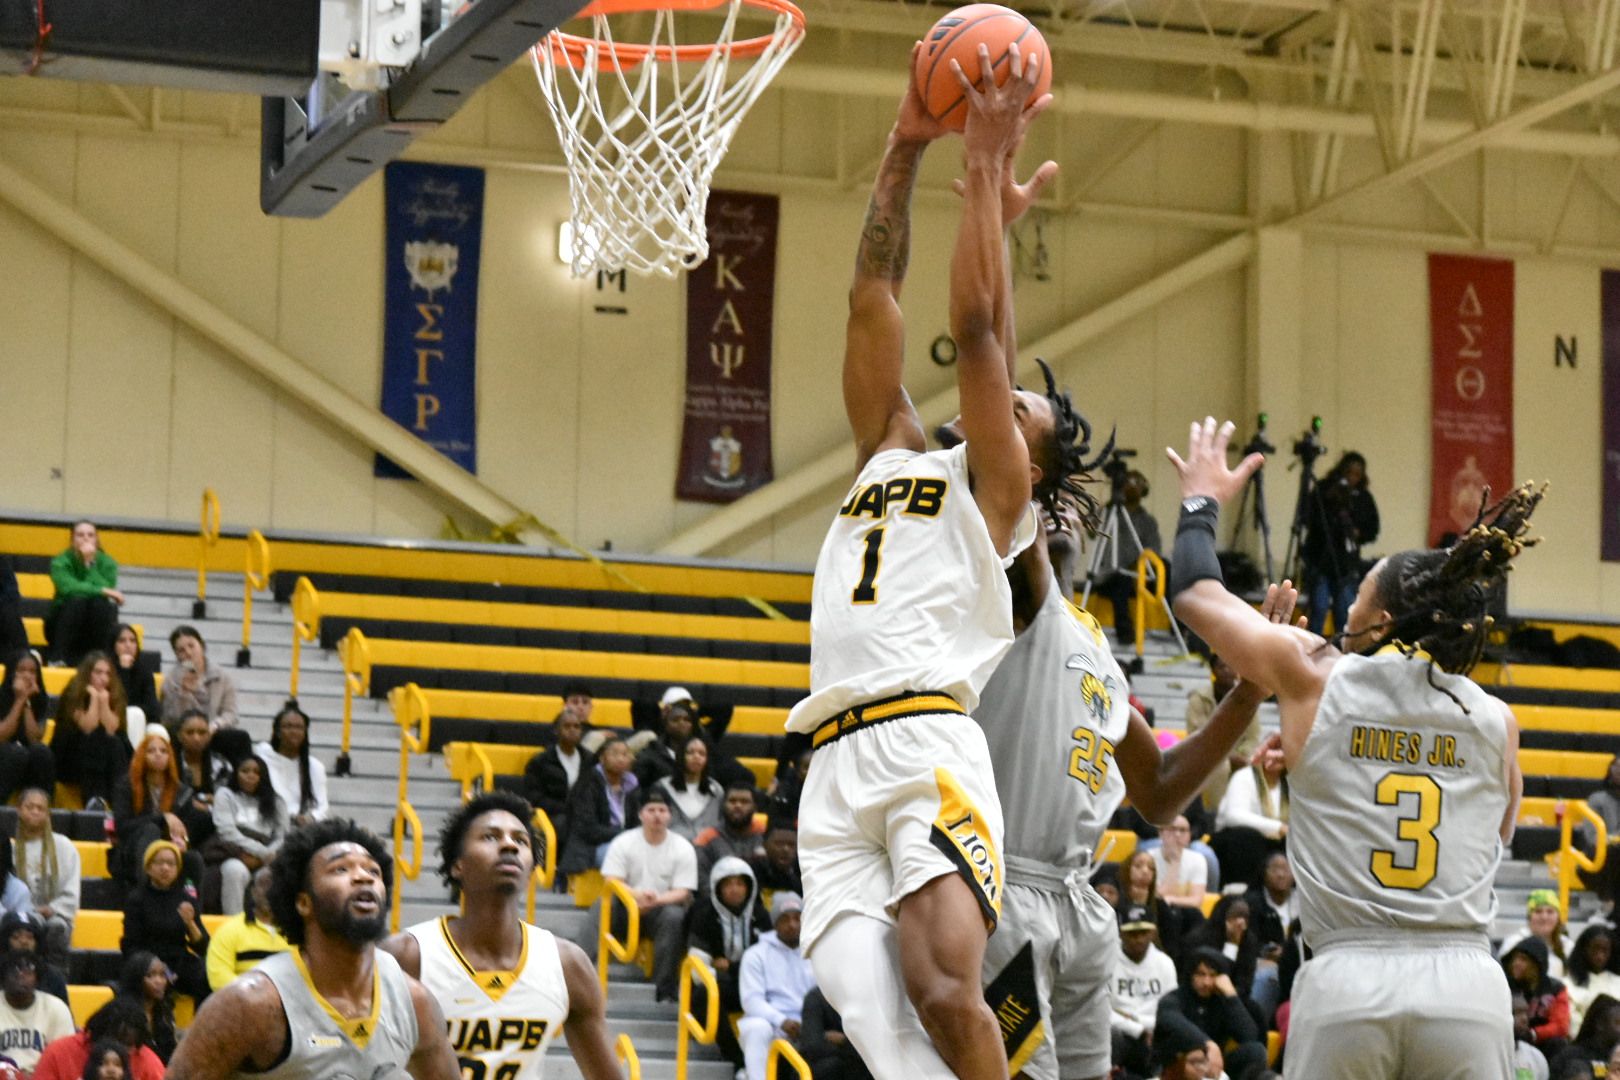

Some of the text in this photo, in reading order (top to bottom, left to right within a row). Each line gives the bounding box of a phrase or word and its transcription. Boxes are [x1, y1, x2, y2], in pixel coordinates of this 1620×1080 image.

[1555, 334, 1577, 369] N
[851, 526, 888, 606] 1
[1067, 725, 1116, 796] 25
[1350, 726, 1466, 768] HINES JR.
[1369, 771, 1443, 891] 3
[447, 1017, 550, 1052] UAPB
